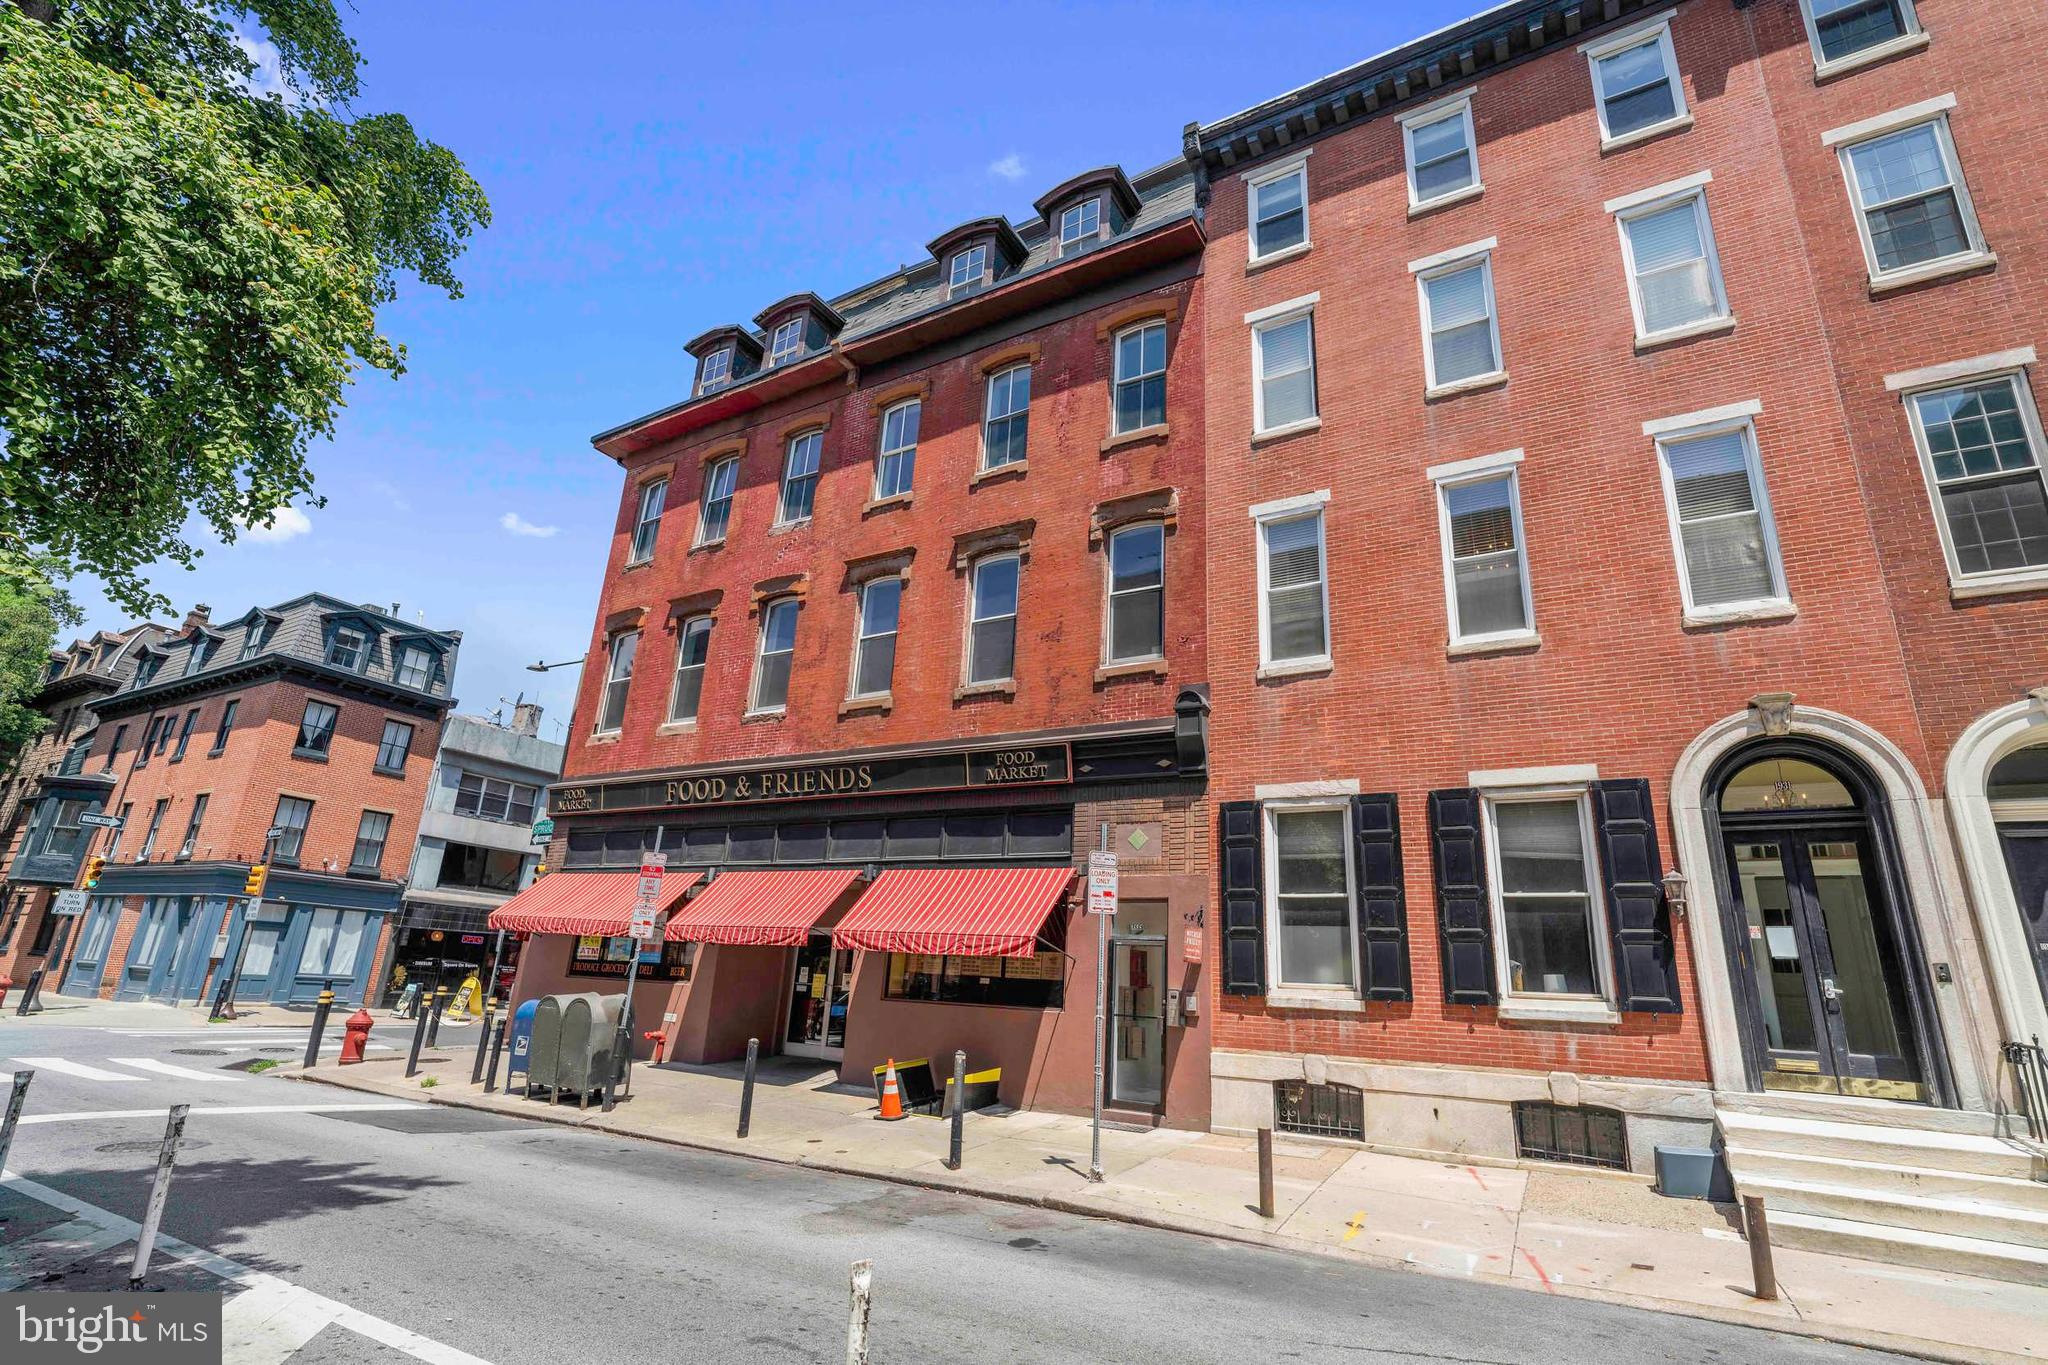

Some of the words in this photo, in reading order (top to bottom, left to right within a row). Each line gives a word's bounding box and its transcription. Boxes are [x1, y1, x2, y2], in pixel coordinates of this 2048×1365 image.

[996, 751, 1035, 765] FOOD
[985, 765, 1048, 780] MARKET
[666, 778, 726, 802] FOOD
[735, 775, 751, 797] &
[760, 765, 872, 796] FRIENDS
[564, 789, 586, 799] FOOD
[558, 799, 592, 810] MARKET
[1091, 870, 1116, 878] LOADING
[580, 947, 599, 955] ATM
[573, 962, 599, 972] PRODUCE
[639, 965, 653, 975] DELI
[670, 966, 686, 977] BEER
